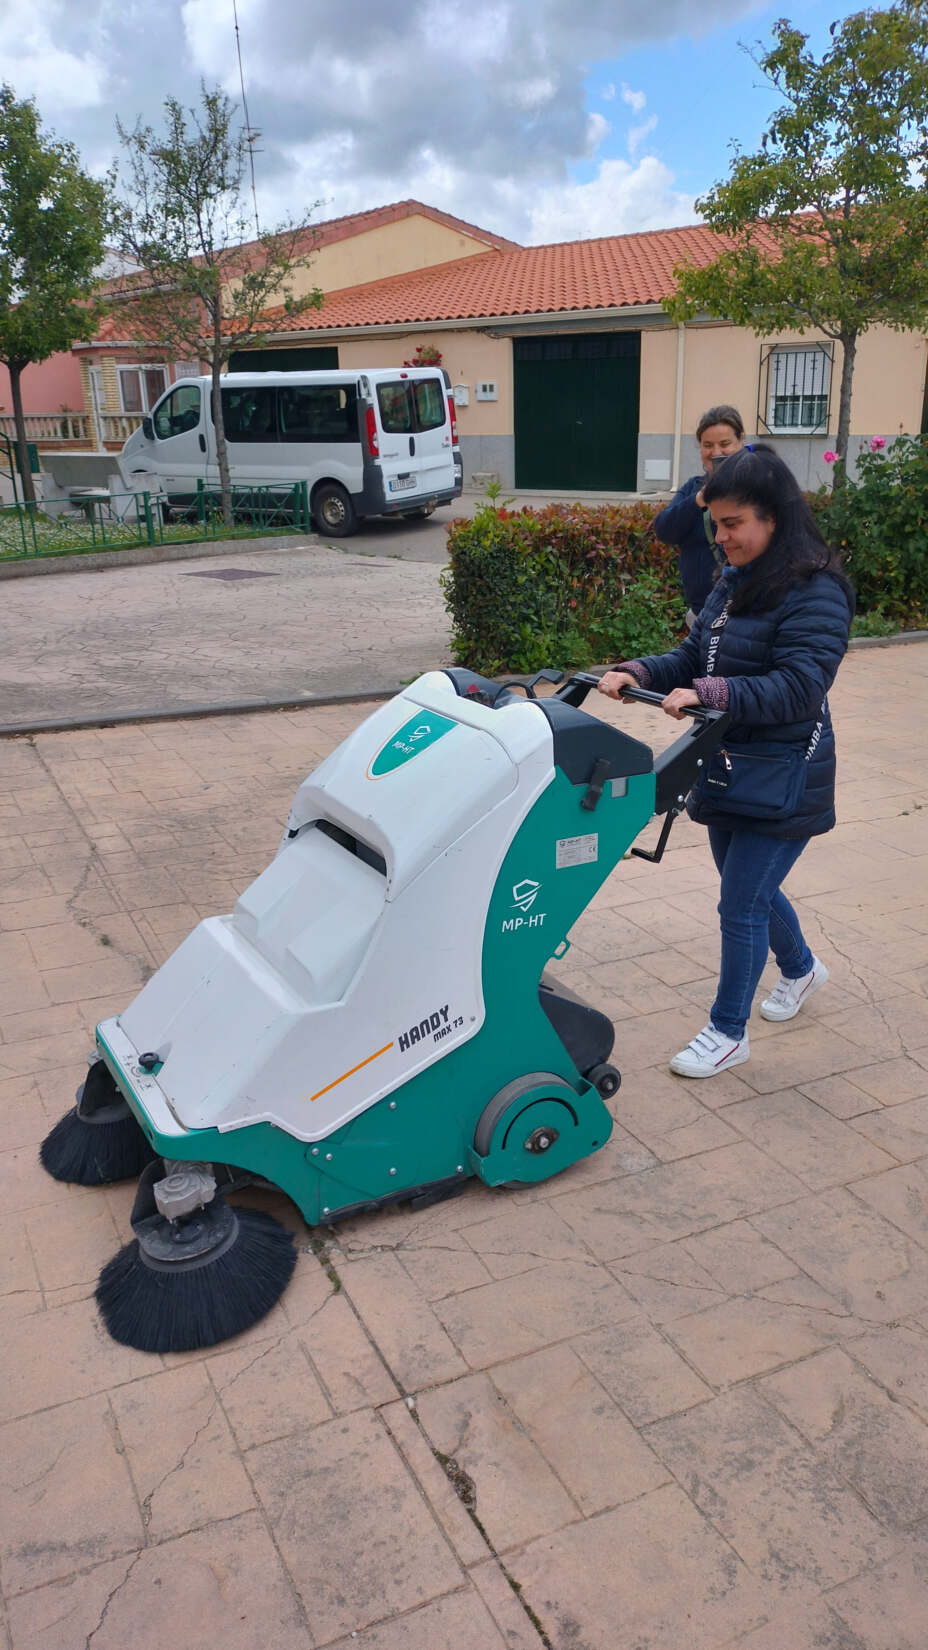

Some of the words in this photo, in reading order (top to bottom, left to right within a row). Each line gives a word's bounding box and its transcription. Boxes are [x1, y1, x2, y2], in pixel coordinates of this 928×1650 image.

[706, 635, 720, 678] BIMB
[501, 913, 547, 933] MP-HT
[398, 1004, 449, 1053] HANDY
[433, 1024, 452, 1043] MAX
[453, 1016, 464, 1028] 73
